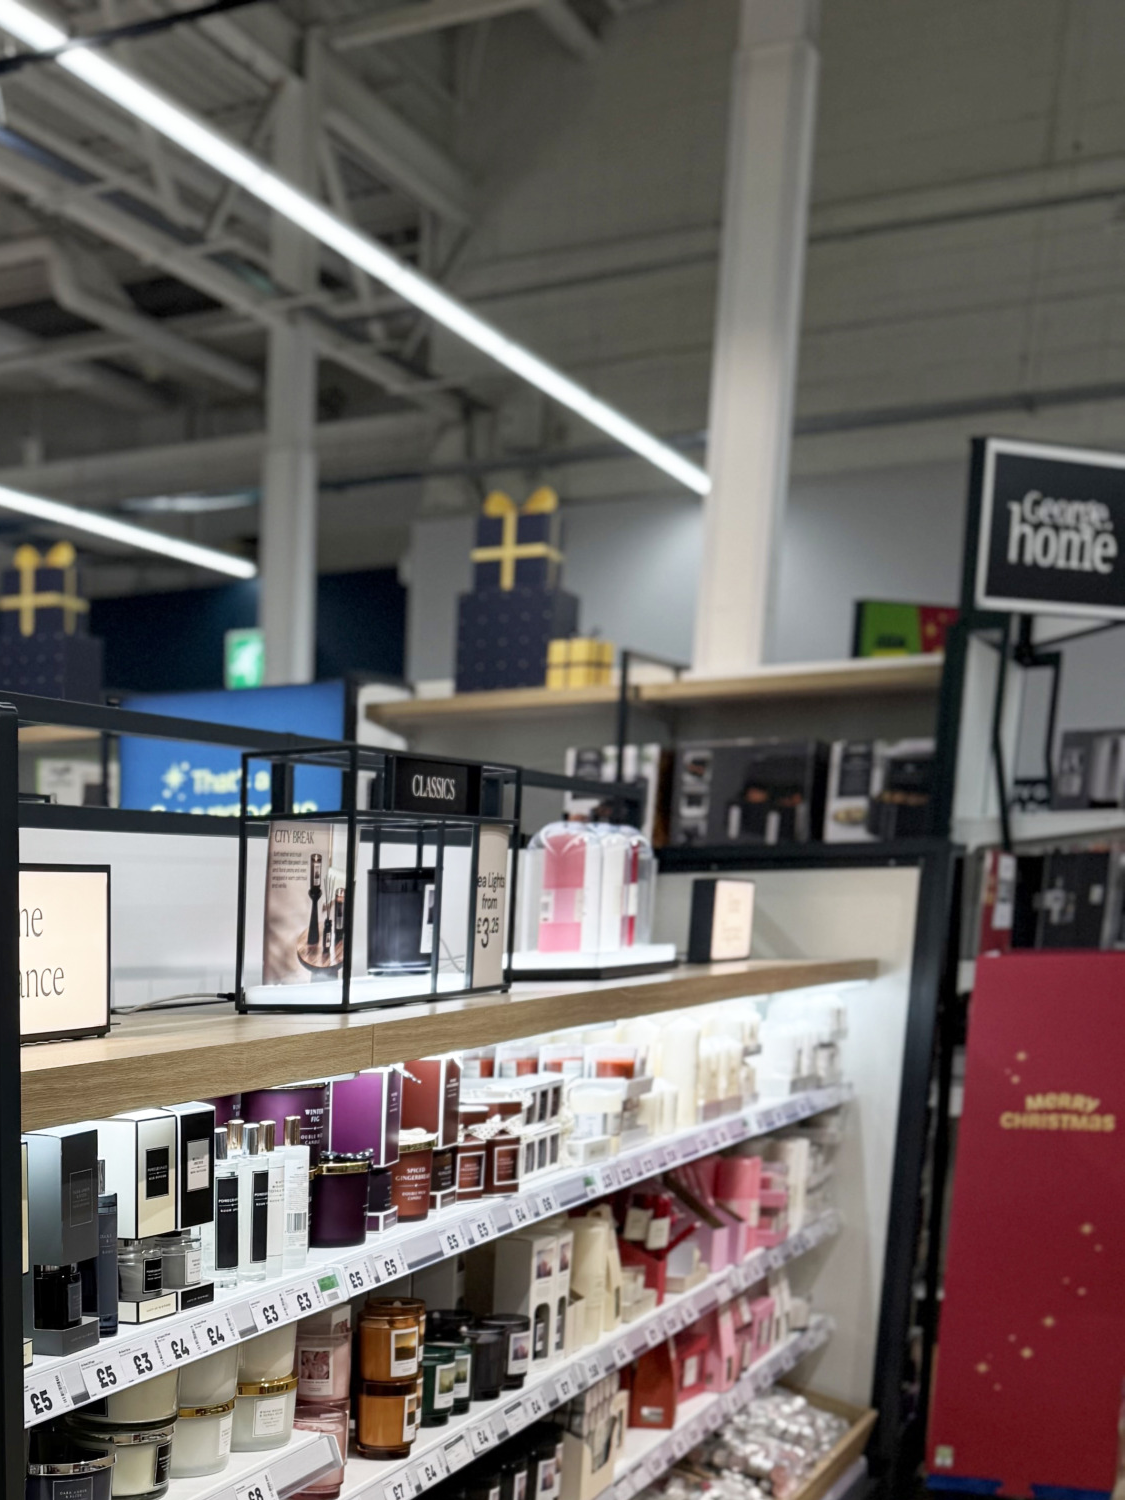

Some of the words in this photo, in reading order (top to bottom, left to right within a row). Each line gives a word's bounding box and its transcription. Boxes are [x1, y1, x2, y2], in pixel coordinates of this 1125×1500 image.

[1007, 500, 1118, 574] home
[412, 774, 456, 800] CLASSICS
[274, 828, 292, 843] CITY
[292, 830, 315, 845] BREAK
[488, 872, 505, 893] Lights
[481, 893, 498, 910] from
[476, 917, 499, 948] £3.25
[515, 1207, 527, 1222] £4
[477, 1222, 489, 1237] £5
[446, 1234, 459, 1250] £5
[384, 1258, 398, 1276] £5
[349, 1271, 364, 1289] £5
[296, 1291, 312, 1311] £3
[262, 1304, 279, 1325] £3
[206, 1325, 225, 1346] £4
[170, 1338, 190, 1360] £4
[133, 1351, 154, 1375] £3
[96, 1364, 117, 1389] £5
[29, 1389, 53, 1415] £5
[476, 1430, 489, 1445] £4
[424, 1465, 437, 1482] £4
